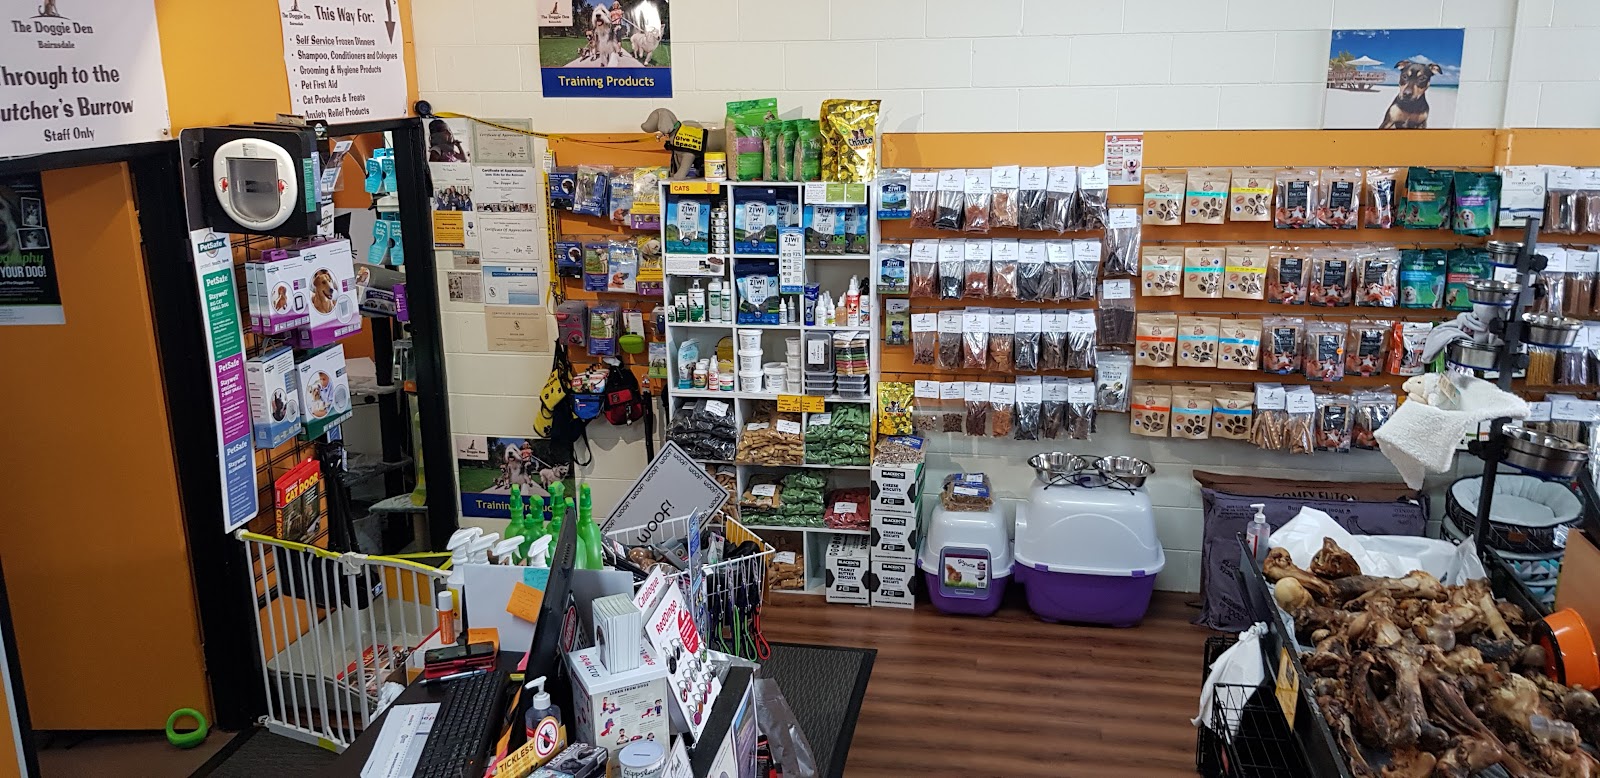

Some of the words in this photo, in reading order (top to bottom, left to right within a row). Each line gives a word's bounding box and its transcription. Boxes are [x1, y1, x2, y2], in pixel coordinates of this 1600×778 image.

[314, 5, 335, 21] This
[336, 7, 355, 27] Way
[357, 8, 375, 23] For:
[12, 20, 31, 33] The
[34, 21, 70, 36] Doggie
[73, 23, 93, 34] Den
[38, 41, 75, 49] Bairnsdale
[295, 34, 309, 45] Self
[311, 35, 335, 45] Service
[336, 36, 353, 45] Frozen
[354, 37, 375, 46] Dinners
[297, 50, 330, 62] Shampoo,
[330, 51, 366, 60] Conditioners
[366, 51, 375, 60] and
[376, 51, 398, 61] Colognes
[72, 67, 88, 83] to
[93, 64, 120, 83] the
[300, 66, 329, 76] Grooming
[330, 65, 335, 74] &
[337, 65, 359, 76] Hygiene
[360, 65, 381, 74] Products
[301, 80, 312, 90] Pet
[313, 80, 327, 89] First
[328, 80, 338, 89] Aid
[558, 76, 603, 89] Training
[606, 76, 654, 87] Products
[302, 95, 314, 105] Cat
[315, 94, 340, 104] Products
[342, 93, 347, 102] &
[348, 93, 365, 102] Treats
[0, 98, 74, 122] utcher's
[77, 97, 134, 117] Burrow
[305, 110, 327, 120] Anxiety
[328, 108, 344, 119] Relief
[345, 107, 370, 117] Products
[44, 128, 70, 142] Staff
[74, 127, 95, 141] Only
[675, 141, 697, 149] Space
[674, 185, 690, 193] CATS
[200, 241, 222, 251] PetSafe
[0, 266, 25, 278] YOUR
[25, 266, 47, 278] DOG!
[206, 275, 228, 287] PetSafe
[208, 289, 228, 300] Staywell
[219, 359, 239, 373] PetSafe
[220, 374, 239, 386] Staywell
[221, 383, 236, 392] ORIGINAL
[227, 441, 247, 456] PetSafe
[229, 455, 246, 468] Staywell
[660, 449, 673, 465] woof!
[673, 453, 688, 466] woof!
[645, 466, 660, 482] woof!
[689, 467, 703, 480] woof!
[285, 486, 298, 503] CAT
[299, 472, 318, 493] DOOR
[631, 483, 646, 500] woof!
[704, 480, 719, 494] woof!
[476, 500, 511, 510] Trainin
[617, 501, 631, 518] woof!
[637, 499, 675, 543] woof!
[638, 577, 660, 608] Catalogue
[656, 600, 677, 635] RedDingo
[500, 743, 535, 773] TICKLESS
[624, 765, 661, 777] Gippsland
